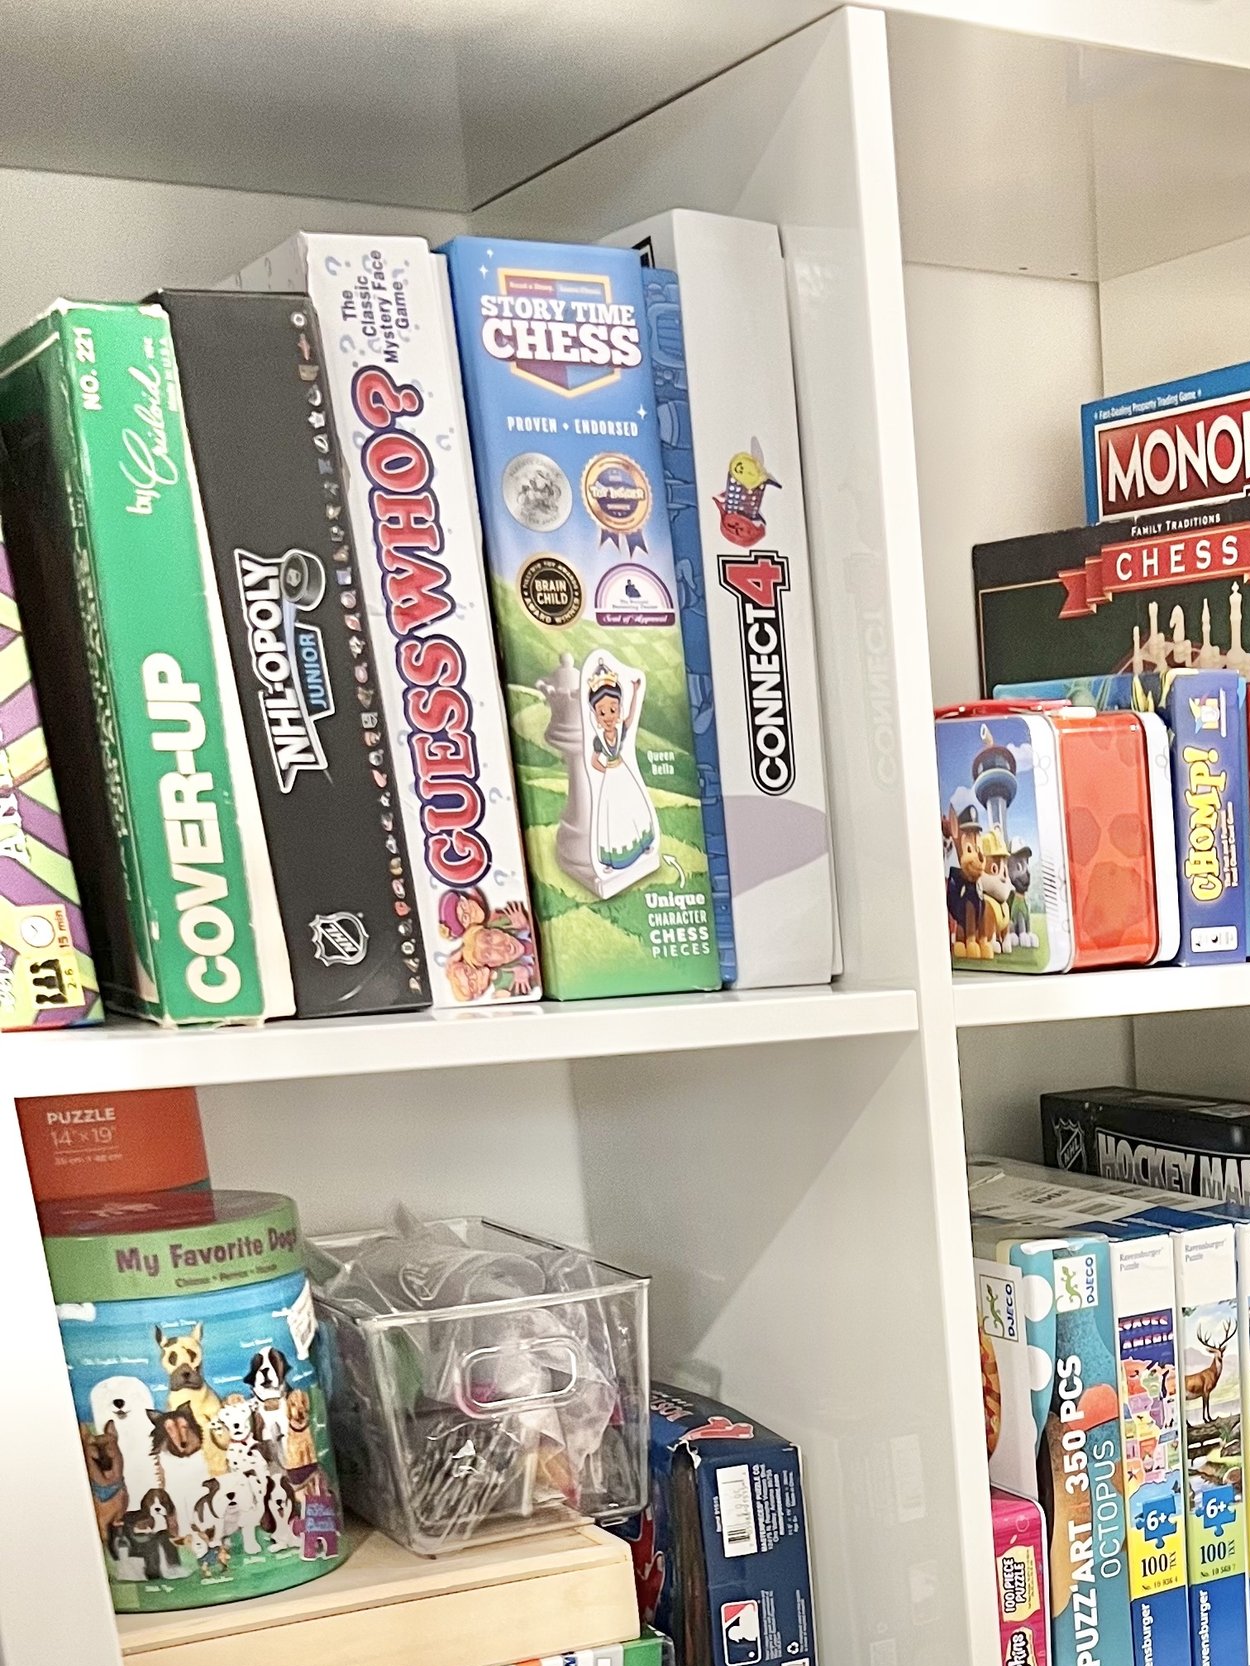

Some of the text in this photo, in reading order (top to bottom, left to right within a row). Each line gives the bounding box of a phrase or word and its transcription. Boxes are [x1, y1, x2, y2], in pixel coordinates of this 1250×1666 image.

[342, 290, 356, 321] The
[355, 275, 376, 337] Classic
[370, 250, 400, 363] Mystery Face
[393, 281, 410, 329] Game
[481, 295, 636, 326] STORY TIME
[482, 317, 642, 367] CHESS
[73, 327, 102, 410] NO. 221
[507, 416, 639, 437] PROVEN ENDORSED
[1131, 513, 1222, 537] FAMILY TRADITIONS
[1116, 535, 1239, 581] CHESS
[535, 579, 566, 592] BRAIN
[537, 592, 568, 605] CHILD
[353, 366, 489, 885] GUESS WHO?
[241, 557, 319, 770] NHL-OPOLY
[301, 634, 327, 710] JUNIOR
[726, 558, 790, 787] CONNECT 4
[647, 750, 675, 764] Queen
[651, 763, 675, 776] Bella
[142, 653, 242, 1003] COVER-UP
[1182, 746, 1227, 901] CHOMP!
[645, 893, 706, 911] Unique
[648, 910, 707, 927] CHARACTER
[328, 922, 358, 955] NHL
[650, 927, 710, 943] CHESS
[652, 942, 711, 959] PIECES
[47, 1107, 116, 1125] PUZZLE
[1097, 1132, 1196, 1195] HOCKEY
[1085, 1256, 1096, 1304] DJECO
[1006, 1283, 1017, 1337] DJECO
[1057, 1354, 1086, 1423] PCS
[1063, 1430, 1089, 1494] 350
[1095, 1440, 1122, 1578] OCTOPUS
[1146, 1509, 1167, 1531] 6+
[1205, 1496, 1227, 1519] 6+
[1004, 1557, 1015, 1613] 100 PIECE
[1015, 1561, 1026, 1604] PUZZLE
